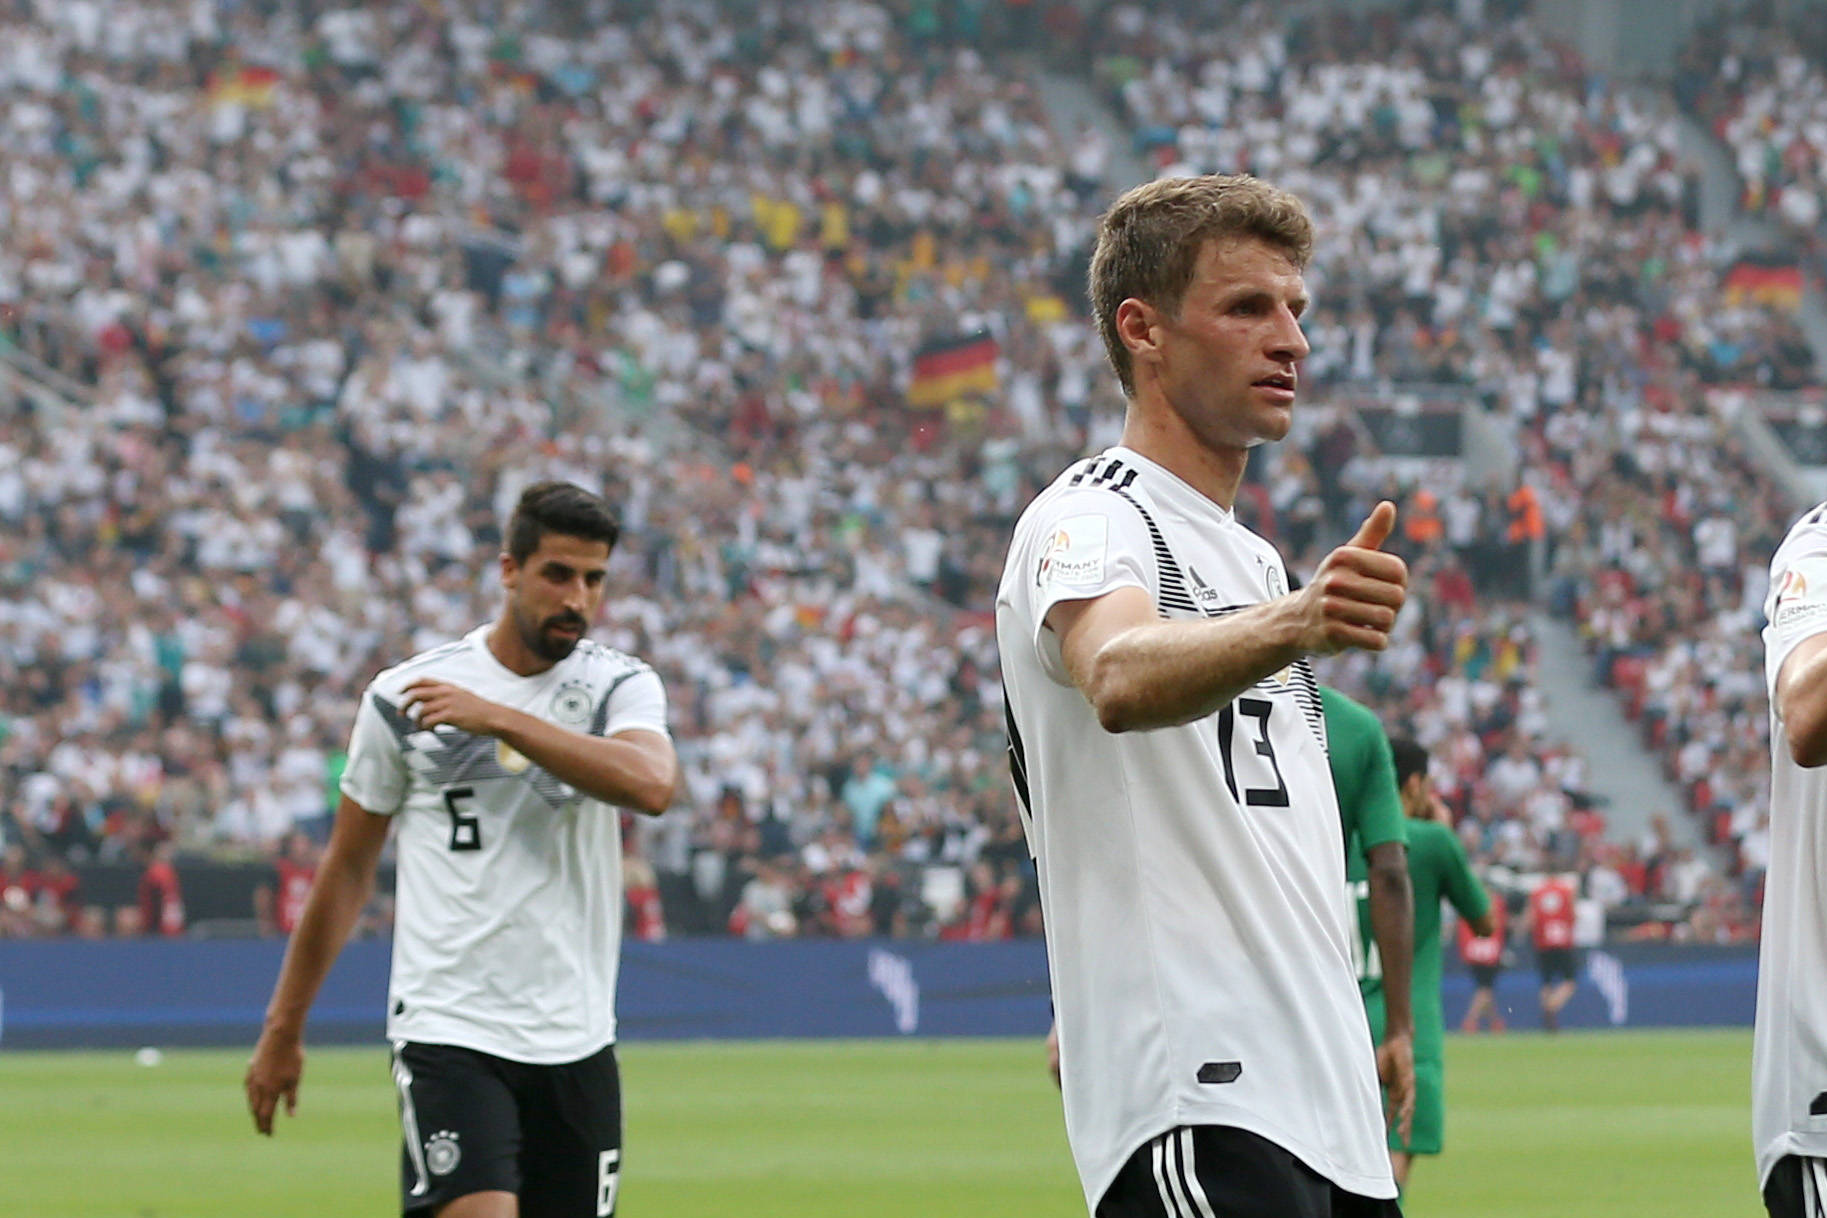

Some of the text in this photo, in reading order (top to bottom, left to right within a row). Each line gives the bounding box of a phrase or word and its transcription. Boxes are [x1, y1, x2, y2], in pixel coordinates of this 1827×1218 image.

[1217, 698, 1290, 808] 13
[444, 788, 481, 850] 6
[597, 1149, 621, 1217] 6
